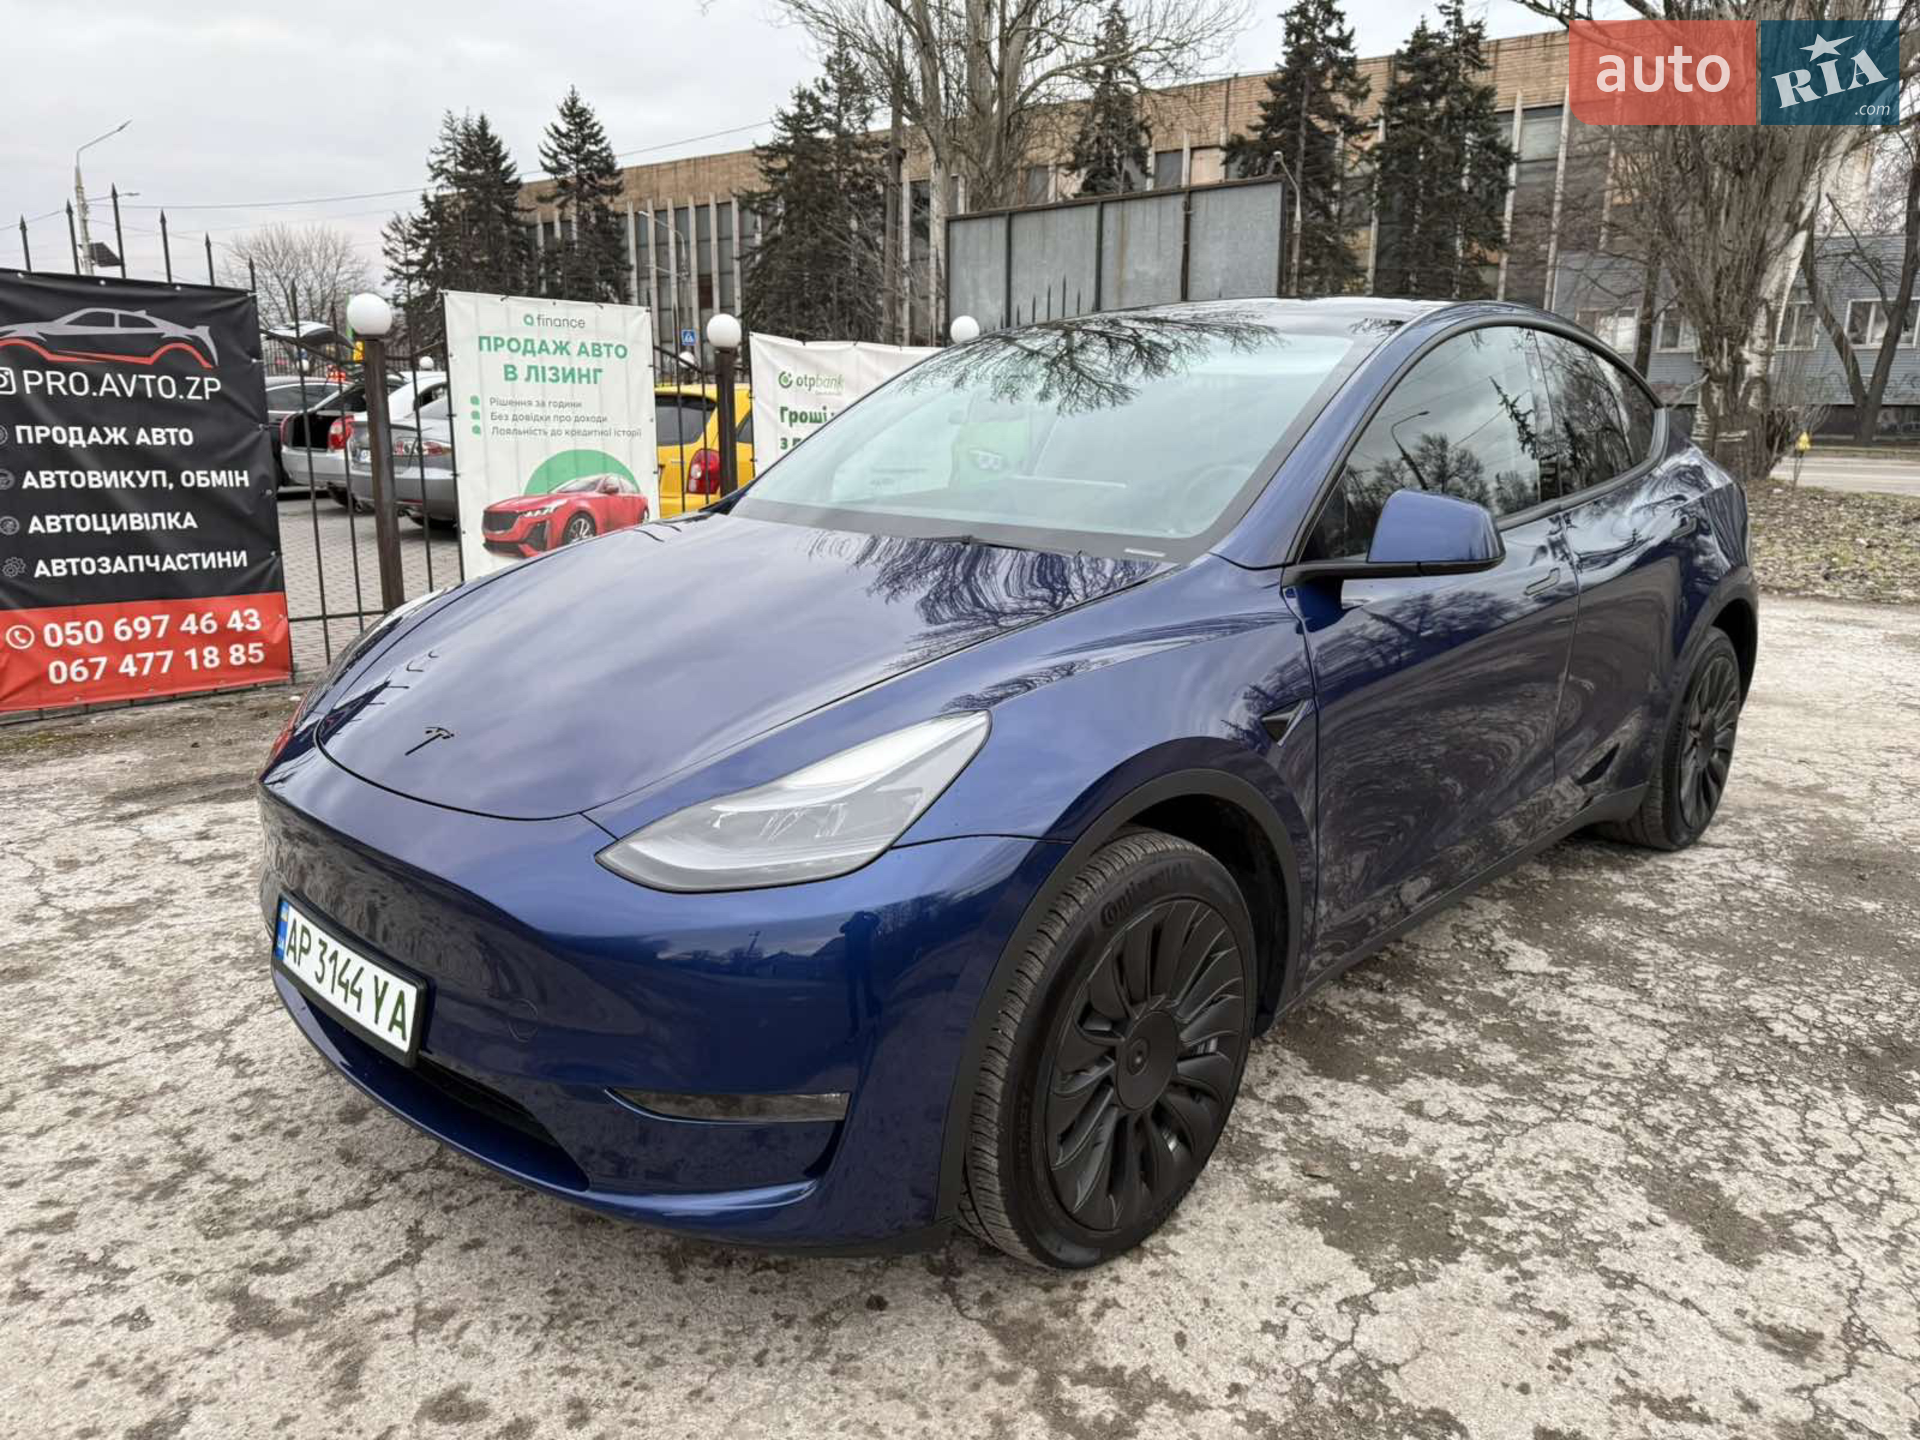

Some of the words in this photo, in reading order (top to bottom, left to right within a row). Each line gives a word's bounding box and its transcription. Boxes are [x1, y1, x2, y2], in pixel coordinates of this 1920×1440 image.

[537, 315, 586, 329] finance
[478, 336, 571, 357] ПРОДАЖ
[577, 342, 628, 359] АВТО
[23, 370, 222, 400] PRO.AVTO.ZP
[503, 364, 518, 382] В
[524, 365, 603, 385] ЛІЗИНГ
[796, 374, 845, 391] otpbank
[489, 397, 533, 408] Рішення
[535, 400, 545, 408] за
[548, 400, 582, 409] години
[490, 411, 508, 421] Без
[512, 412, 550, 423] довідки
[553, 415, 571, 424] про
[574, 415, 607, 424] доходи
[780, 406, 827, 427] Гроші
[15, 425, 129, 448] ПРОДАЖ
[135, 427, 194, 446] АВТО
[491, 426, 548, 437] Лояльність
[551, 429, 563, 438] до
[565, 427, 611, 438] кредитної
[614, 427, 642, 438] історії
[22, 470, 174, 490] АВТОВИКУП,
[180, 470, 250, 488] ОБМІН
[28, 512, 198, 535] АВТОЦИВІЛКА
[33, 550, 249, 578] АВТОЗАПЧАСТИНИ
[43, 620, 103, 647] 050
[114, 615, 170, 642] 697
[180, 612, 217, 636] 46
[227, 608, 262, 632] 43
[48, 657, 108, 685] 067
[118, 650, 173, 677] 477
[184, 646, 220, 670] 18
[229, 643, 265, 667] 85
[286, 918, 312, 966] AP
[314, 938, 364, 1013] 3144
[373, 974, 407, 1041] YA
